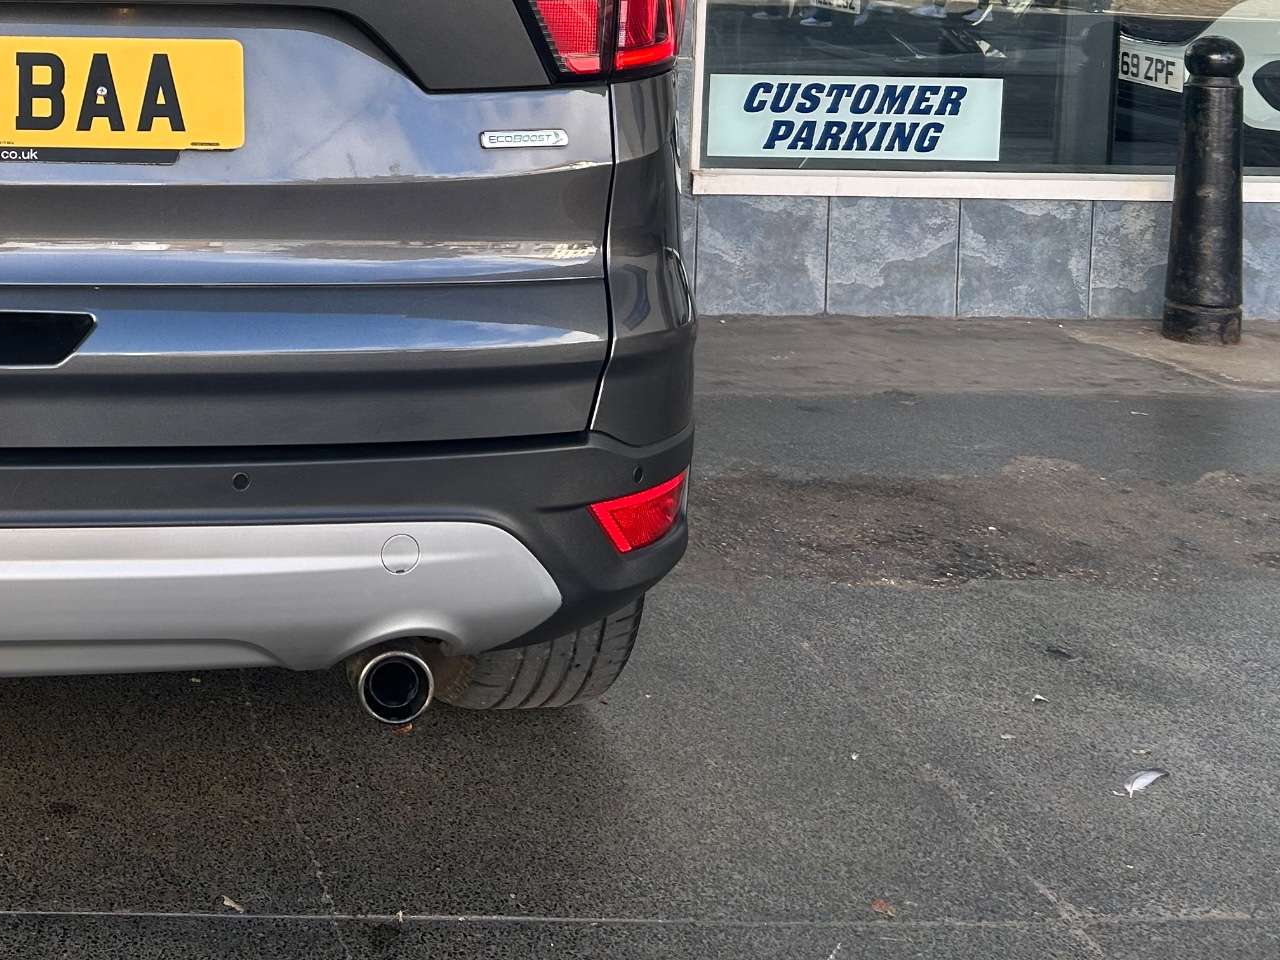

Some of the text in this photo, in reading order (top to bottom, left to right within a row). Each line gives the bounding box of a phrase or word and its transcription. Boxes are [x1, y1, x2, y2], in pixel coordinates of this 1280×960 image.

[1143, 56, 1176, 84] ZPF
[15, 52, 186, 132] BAA
[743, 82, 968, 116] CUSTOMER
[762, 120, 944, 153] PARKING
